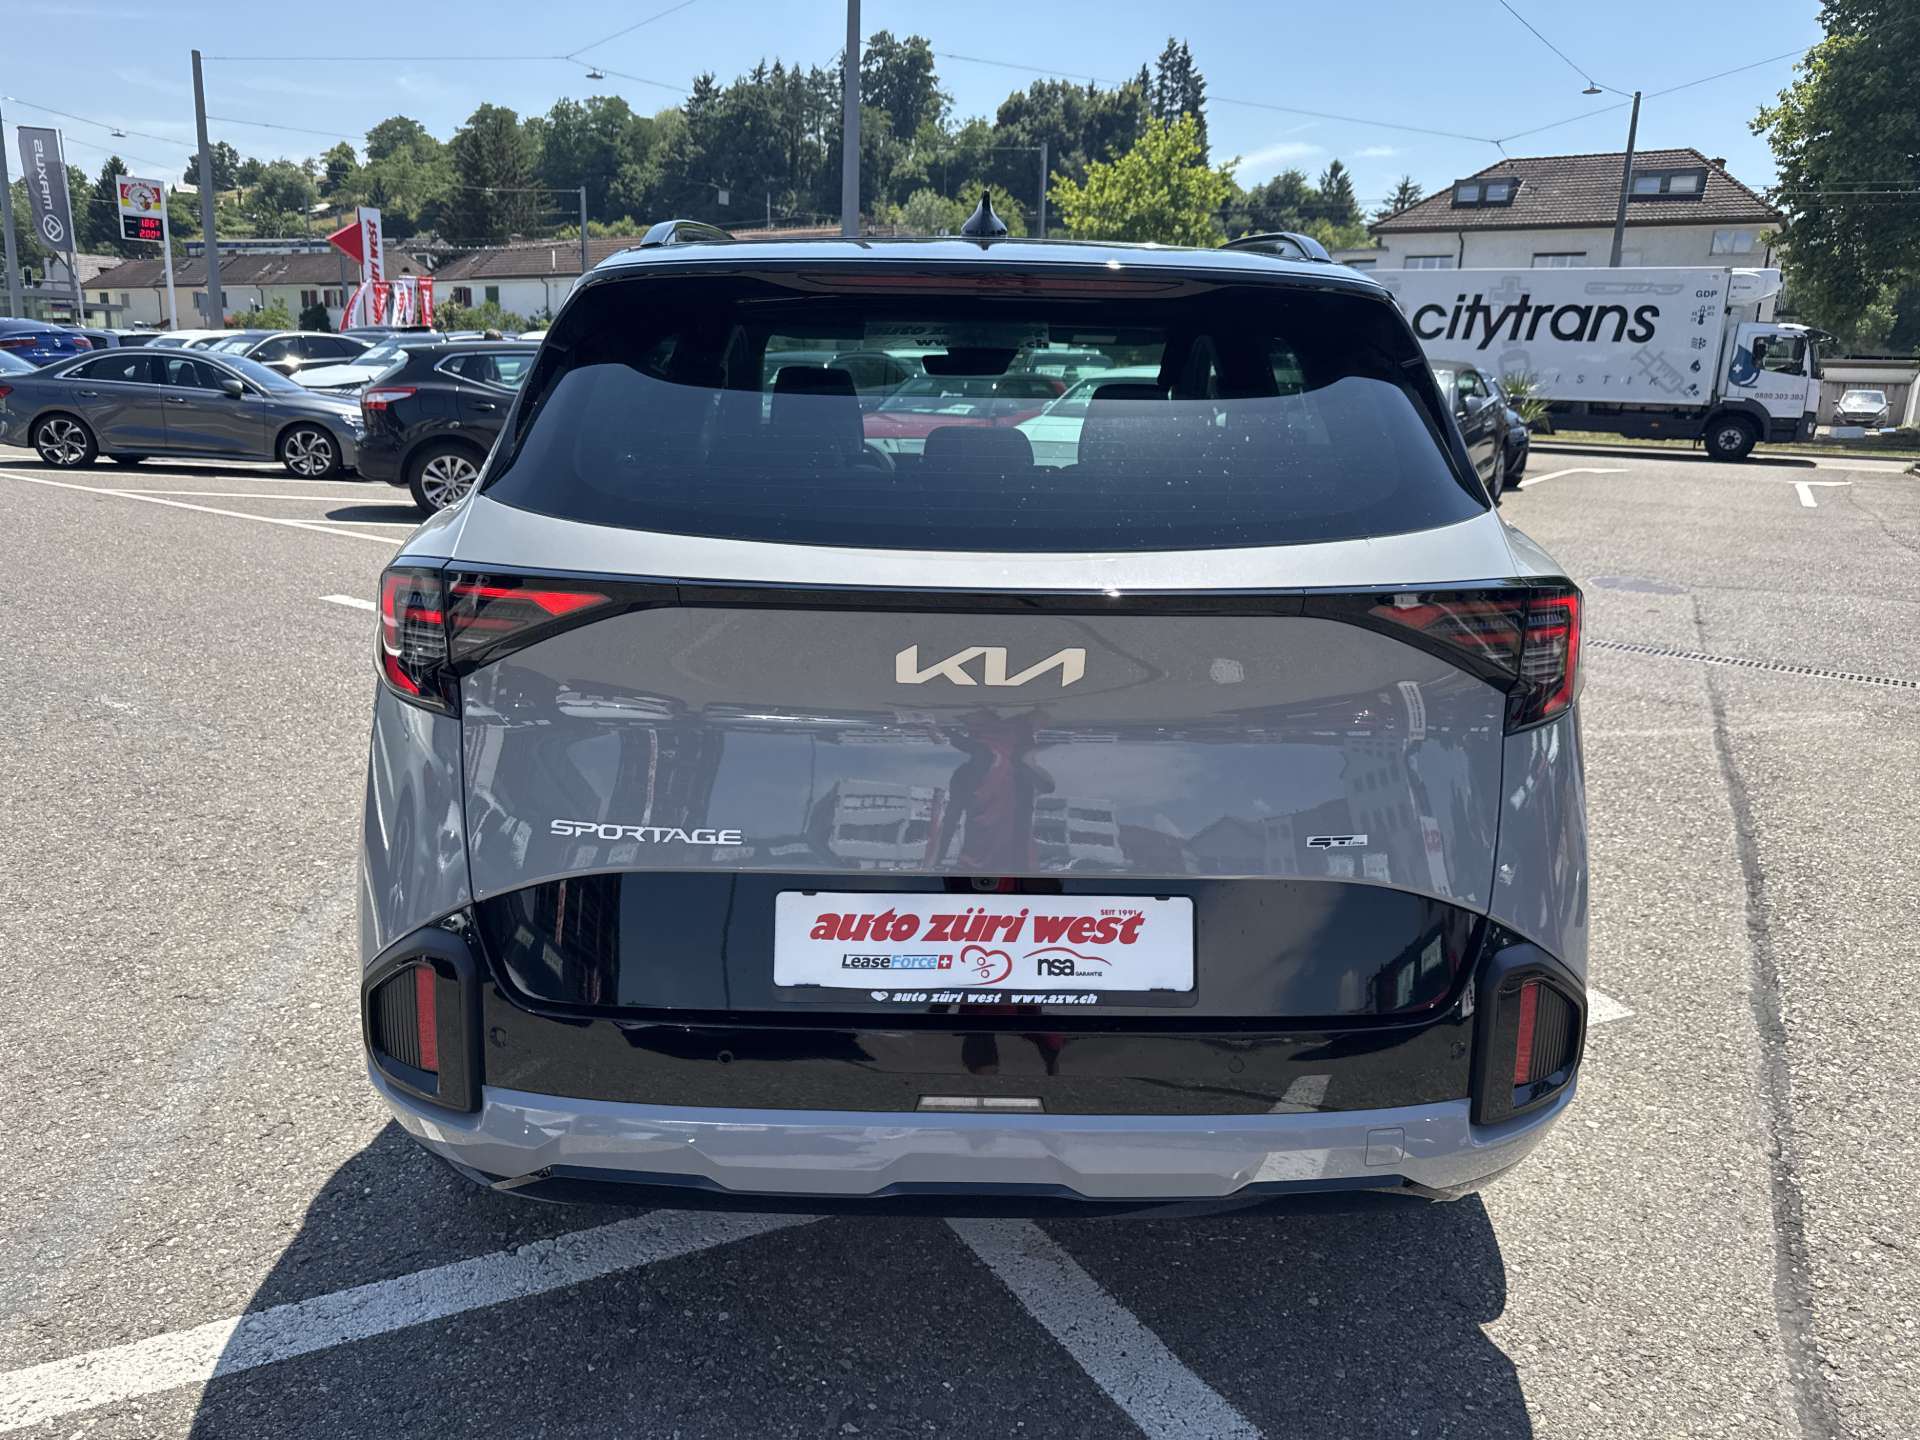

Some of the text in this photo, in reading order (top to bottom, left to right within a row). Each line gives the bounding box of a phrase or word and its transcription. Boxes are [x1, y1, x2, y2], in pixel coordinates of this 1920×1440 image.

[367, 219, 378, 258] west
[1695, 289, 1718, 298] GDP
[1412, 293, 1660, 350] citytrans
[895, 644, 1087, 687] KIA
[550, 819, 743, 845] SPORTAGE
[809, 907, 1145, 945] auto züri west
[841, 953, 938, 969] LeaseForce
[1037, 958, 1074, 977] nsa
[892, 991, 1098, 1005] auto züri west www.azw.ch
